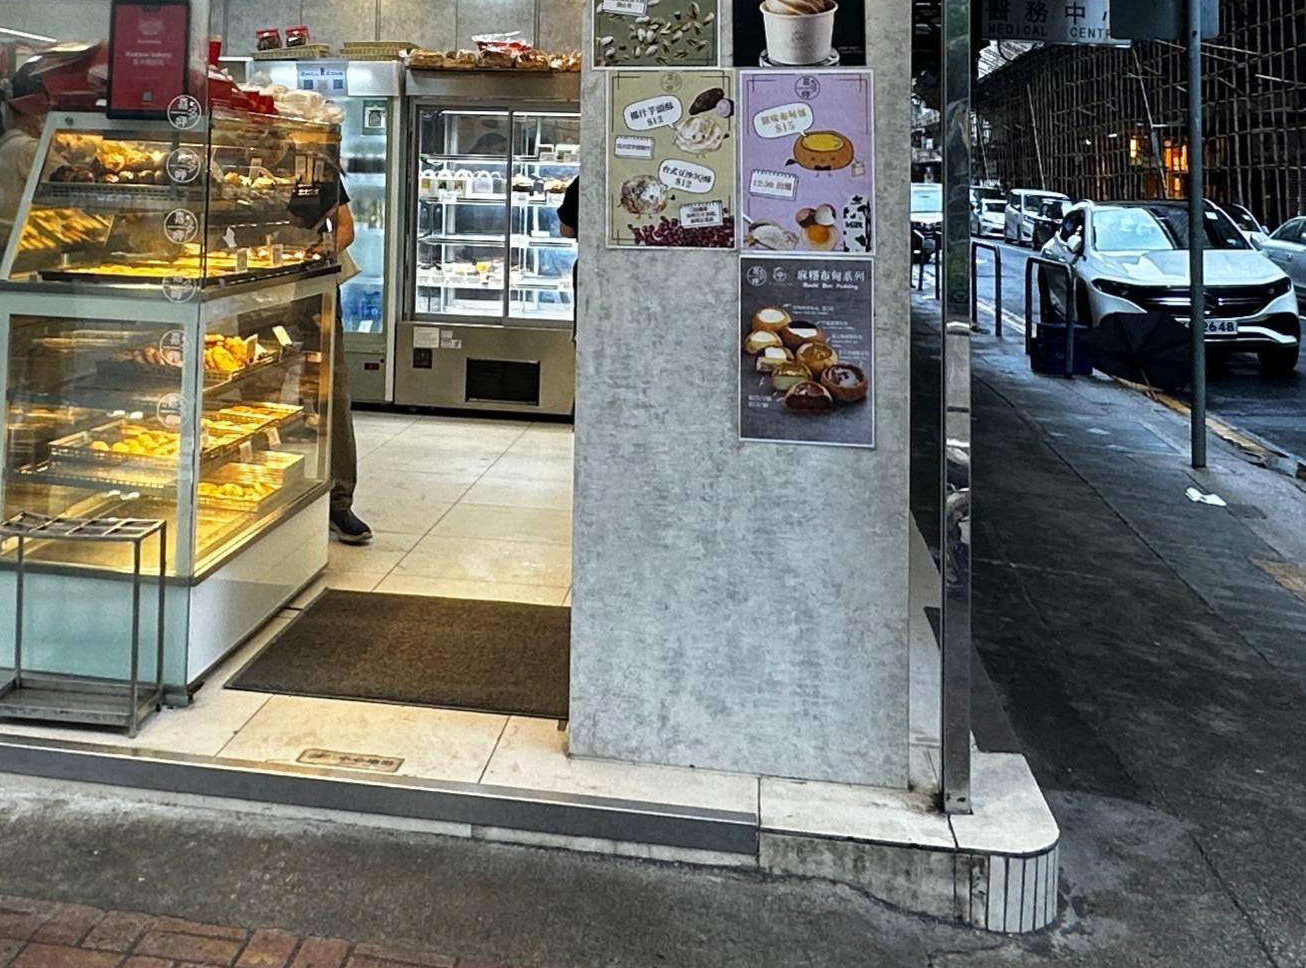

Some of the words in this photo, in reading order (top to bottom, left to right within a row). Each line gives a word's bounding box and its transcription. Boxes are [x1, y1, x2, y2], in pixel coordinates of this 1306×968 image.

[986, 0, 1107, 25] 醫務中
[987, 23, 1048, 37] MEDICAL
[1069, 27, 1111, 38] CENTR
[675, 177, 692, 188] $12
